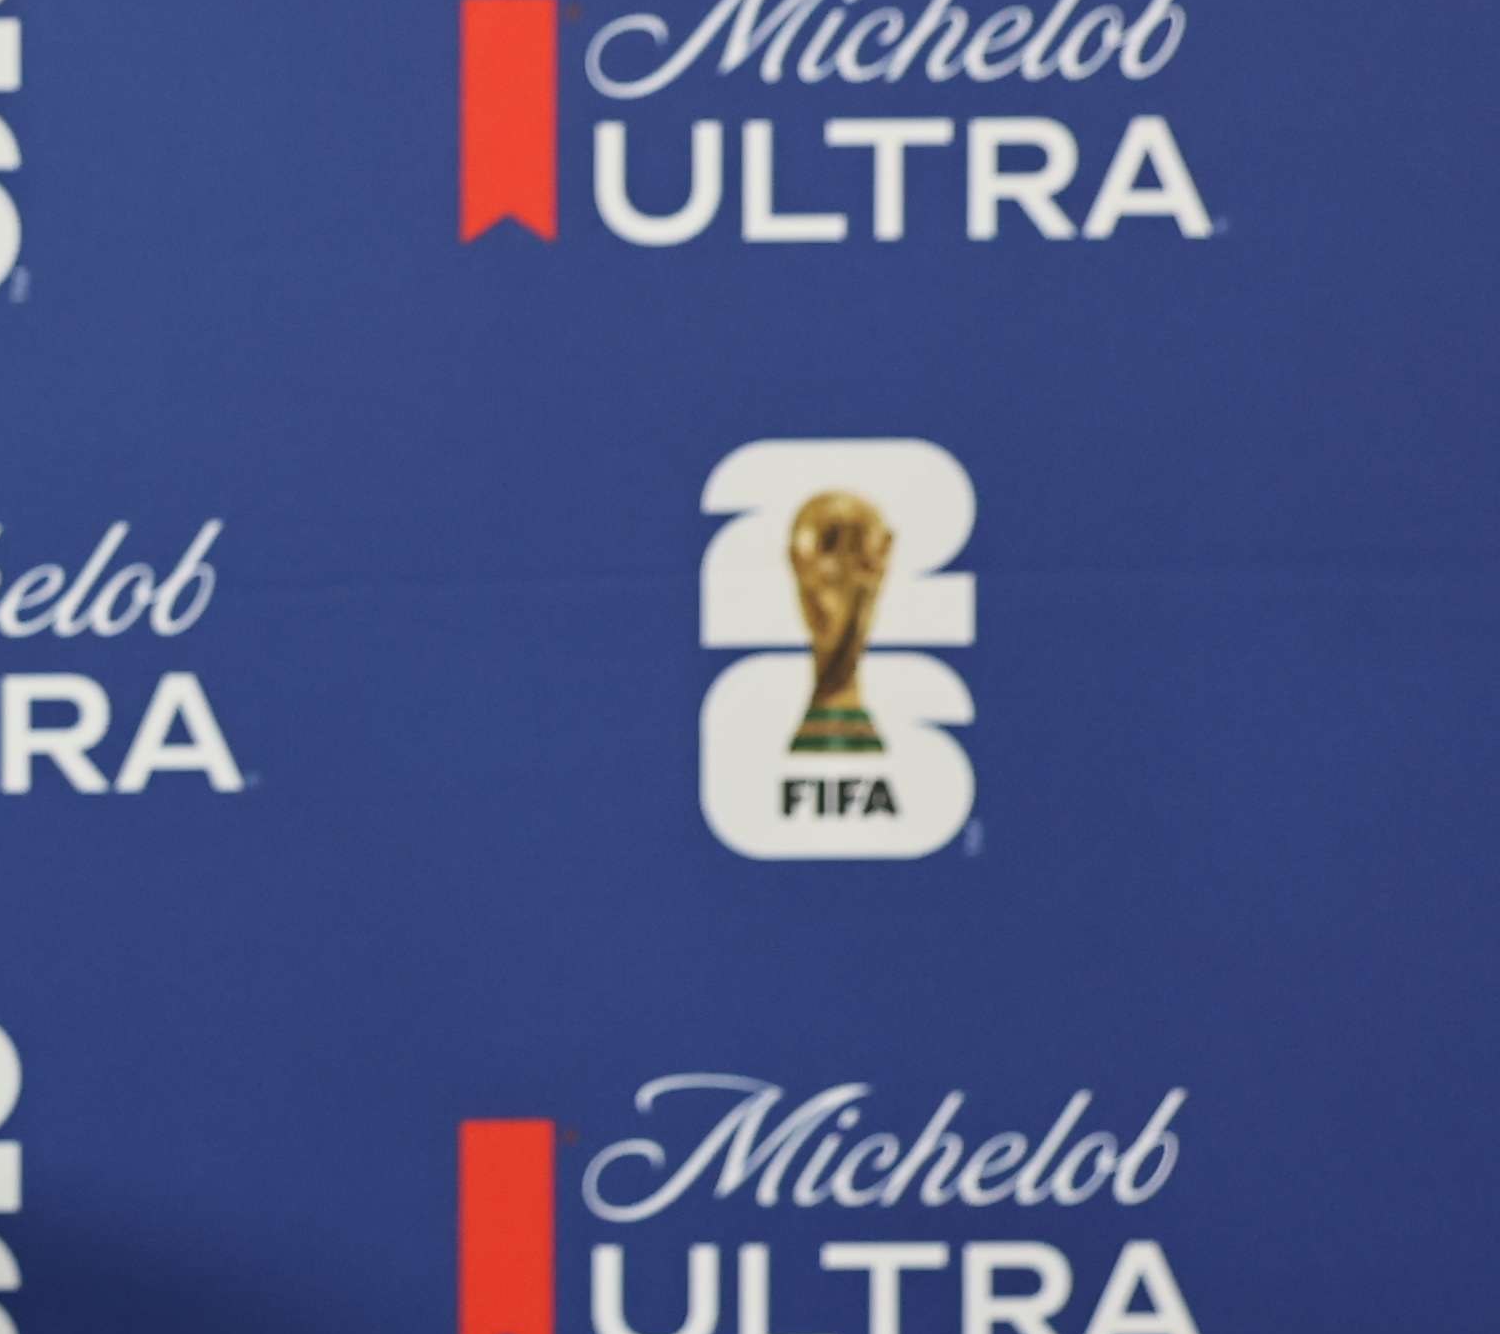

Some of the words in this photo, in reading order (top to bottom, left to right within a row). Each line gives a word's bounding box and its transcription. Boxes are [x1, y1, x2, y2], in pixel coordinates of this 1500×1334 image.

[595, 116, 1213, 245] ULTRA
[782, 779, 897, 816] FIFA
[583, 1074, 1185, 1222] Michelob
